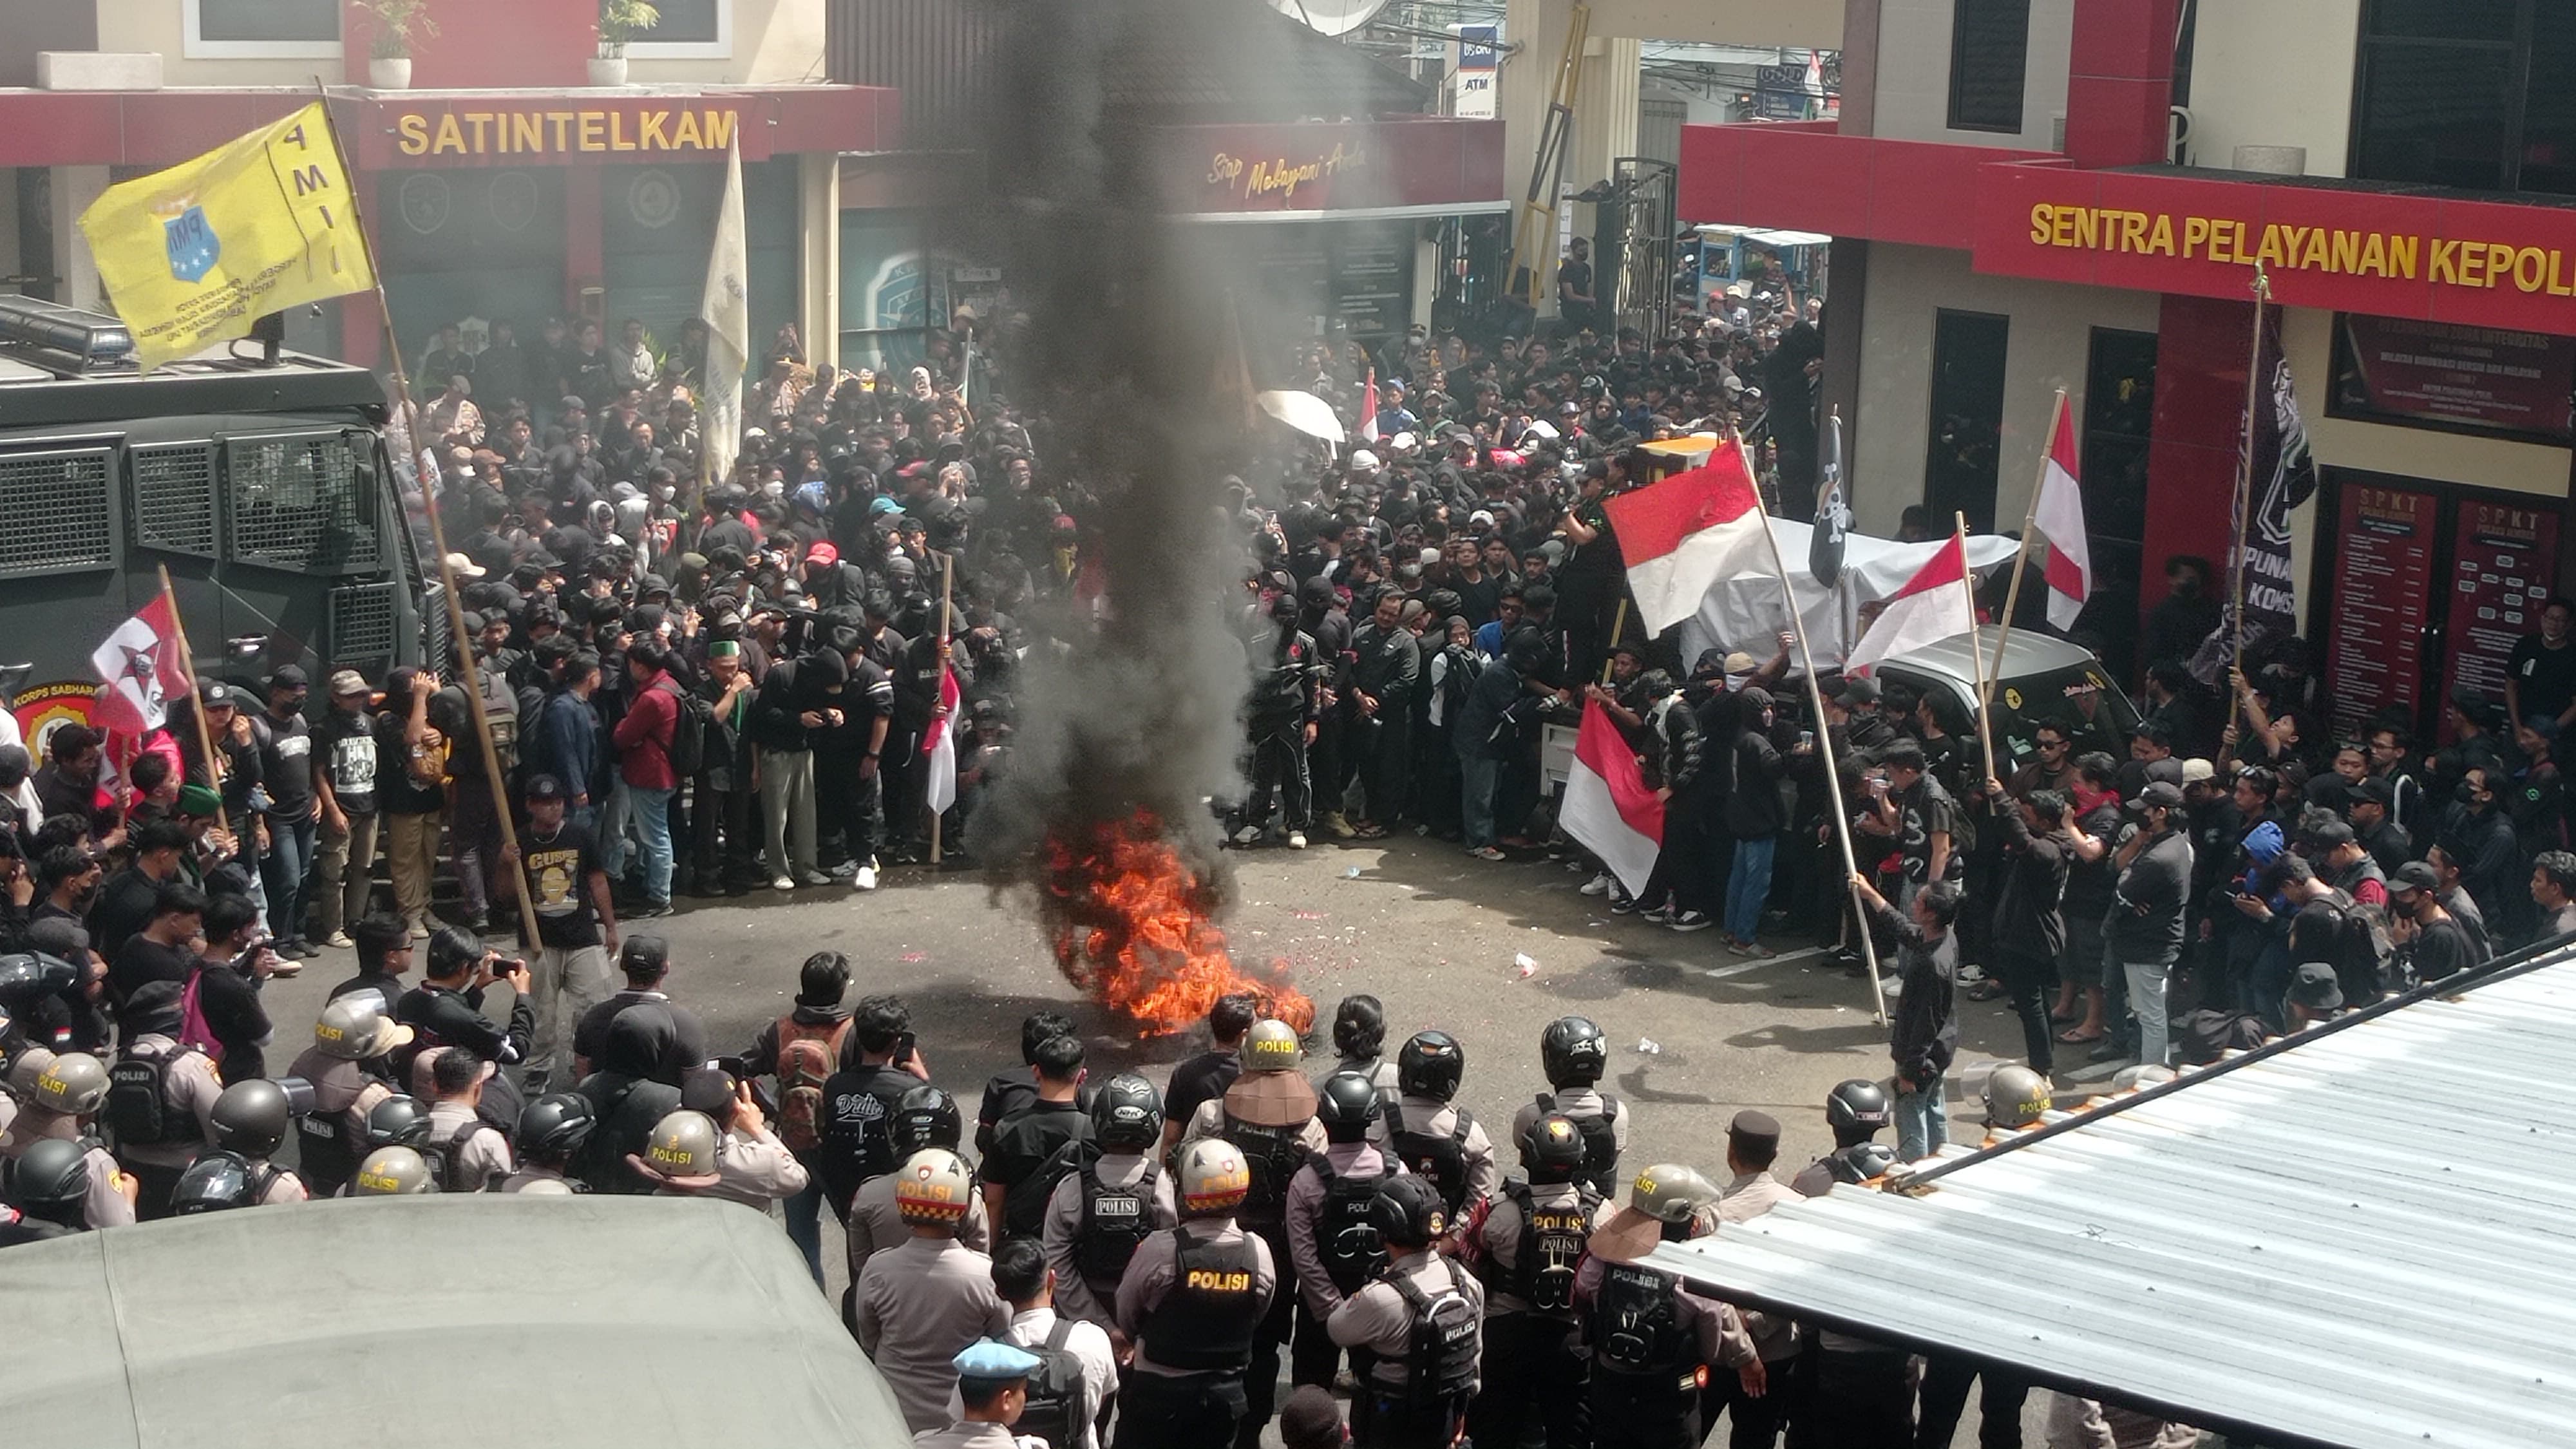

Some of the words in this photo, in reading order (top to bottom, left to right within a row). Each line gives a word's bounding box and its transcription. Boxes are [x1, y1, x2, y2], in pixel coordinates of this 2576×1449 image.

[1464, 79, 1488, 91] ATM
[399, 110, 735, 155] SATINTELKAM
[1207, 153, 1244, 189] Siap
[1244, 155, 1323, 199] Melayani
[1325, 141, 1367, 176] Anda
[2030, 203, 2175, 257] SENTRA
[2183, 217, 2418, 279] PELAYANAN
[2429, 238, 2576, 296] KEPOL
[13, 687, 50, 708] KORPS
[1256, 1041, 1294, 1054] POLISI
[39, 1072, 67, 1095] OLISI
[115, 1071, 149, 1081] POLISI
[1237, 1123, 1279, 1138] POLISI
[652, 1146, 692, 1165] POLISI
[896, 1180, 952, 1201] POLISI
[1097, 1200, 1137, 1214] POLISI
[1542, 1237, 1577, 1251] POLISI
[1188, 1271, 1249, 1291] POLISI
[1612, 1268, 1660, 1289] POLISI
[1444, 1320, 1476, 1343] POLISI
